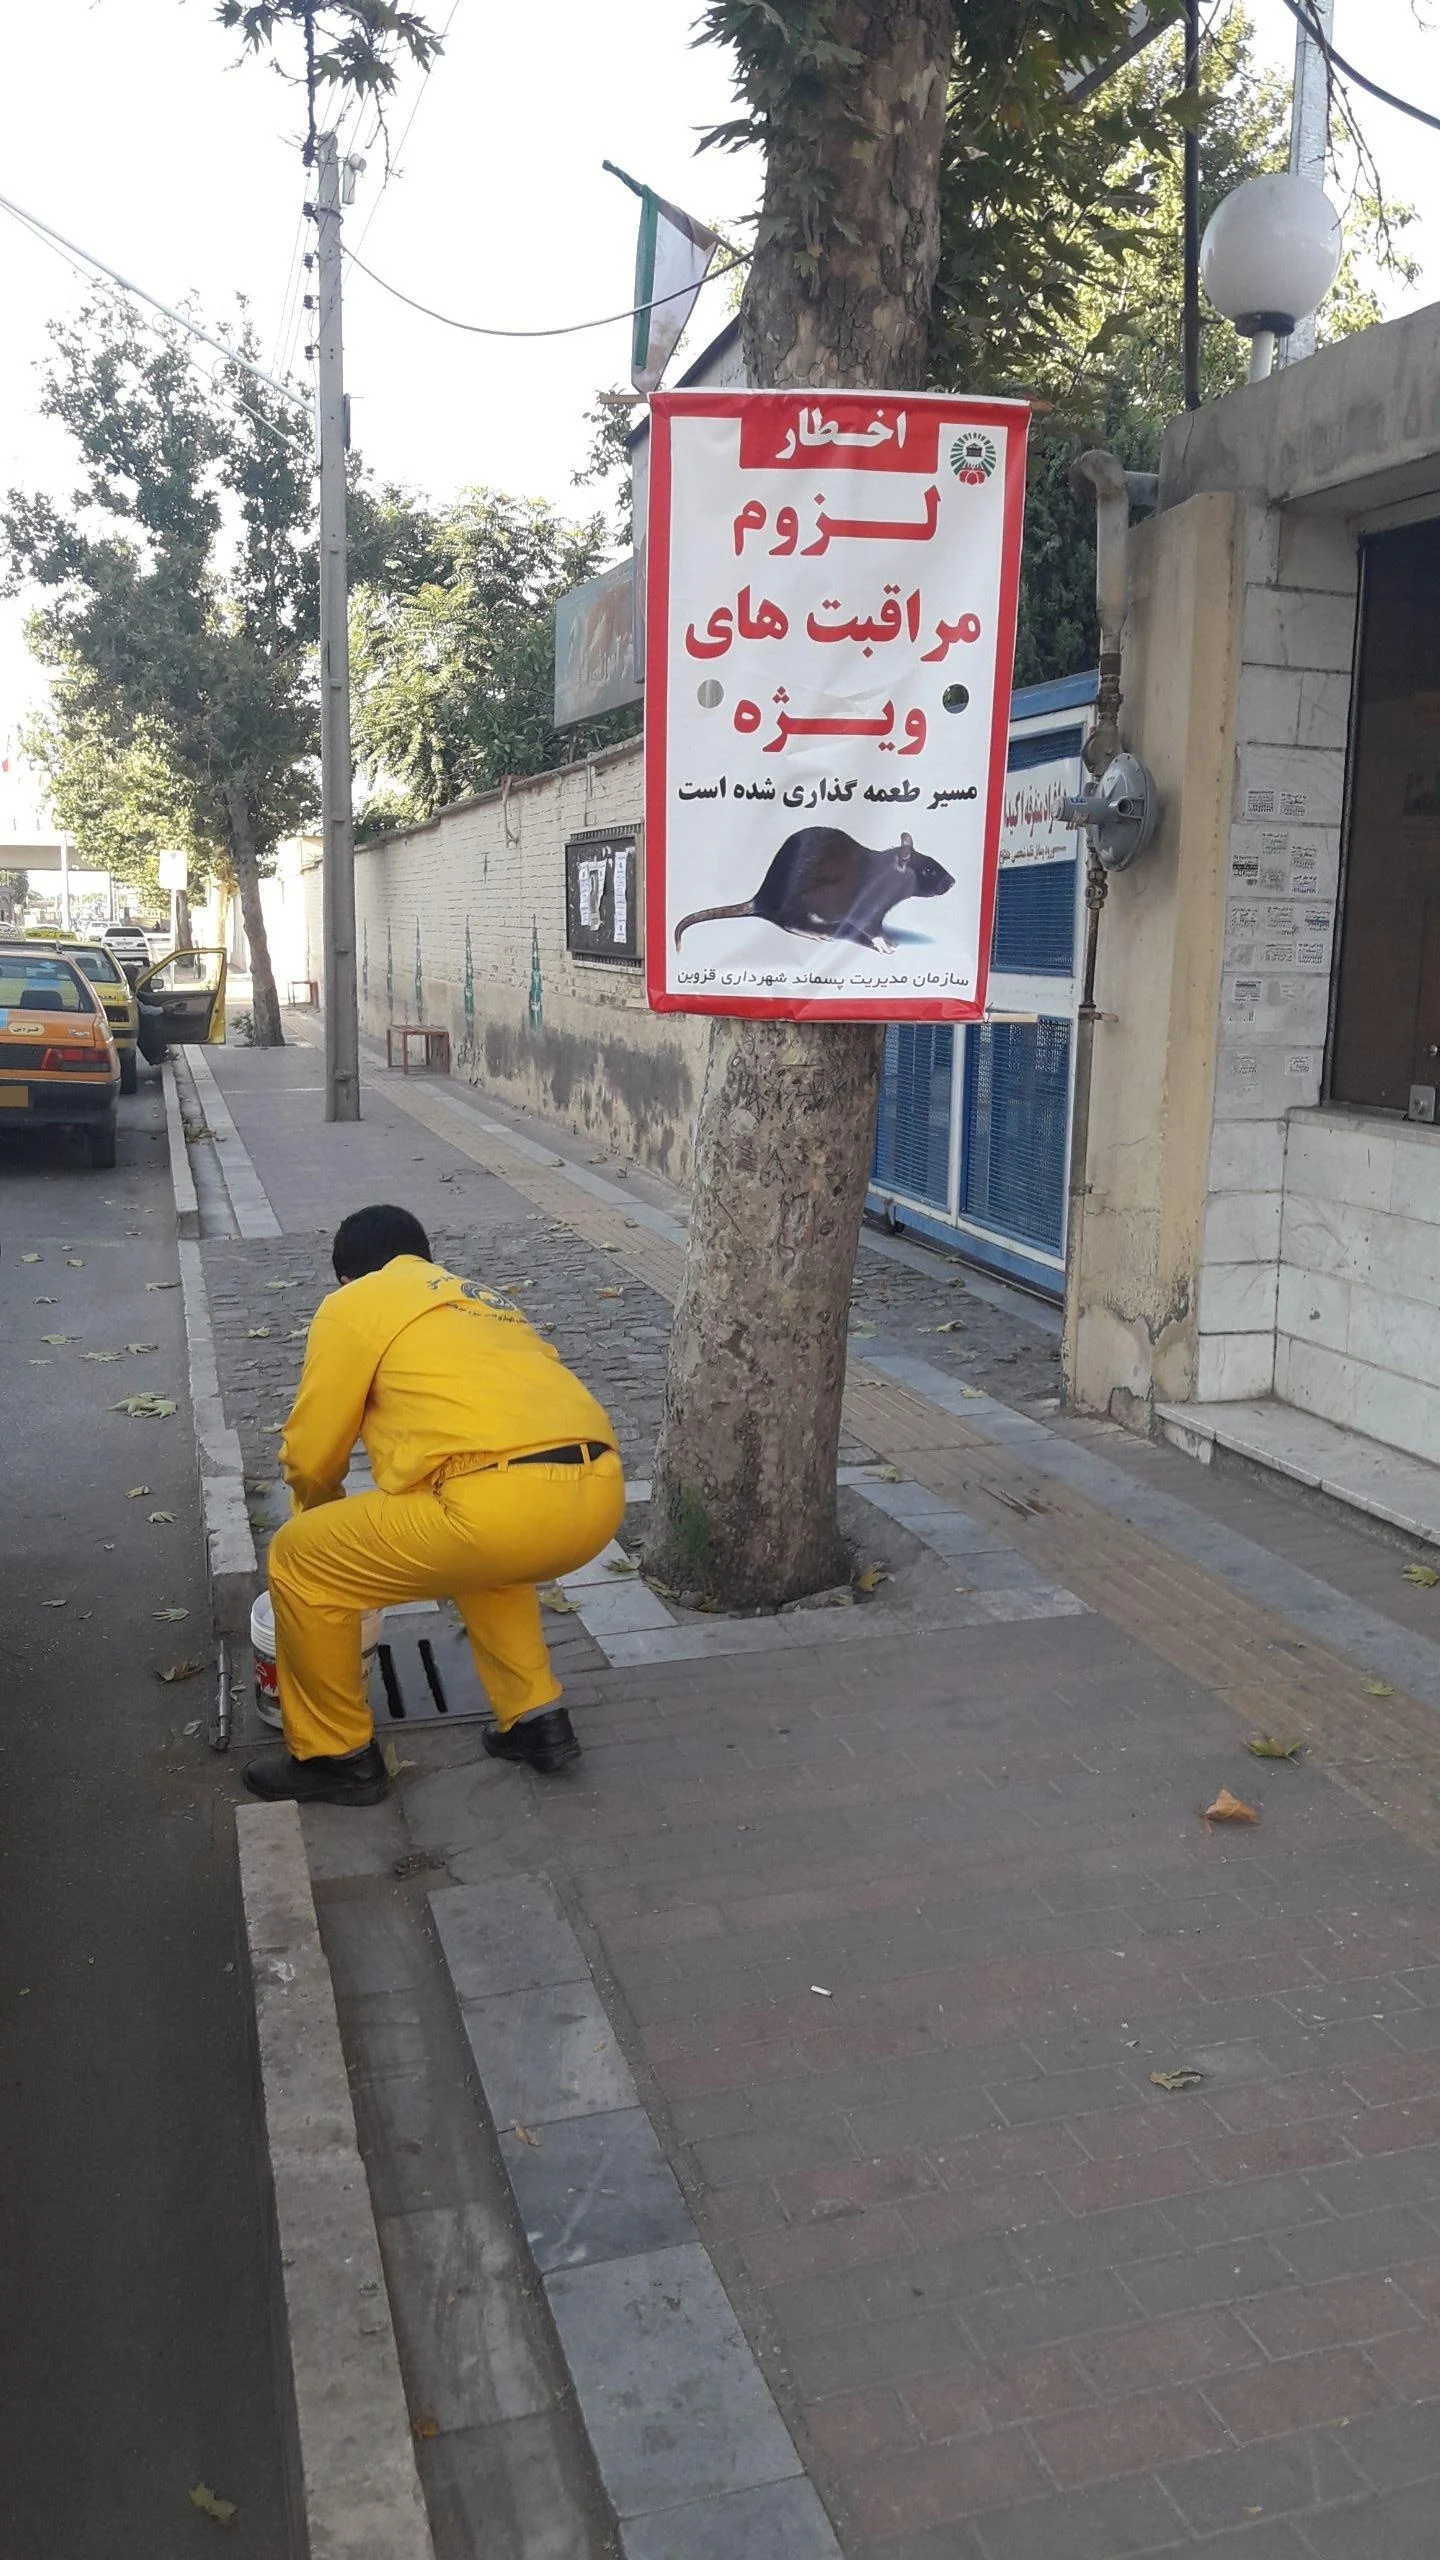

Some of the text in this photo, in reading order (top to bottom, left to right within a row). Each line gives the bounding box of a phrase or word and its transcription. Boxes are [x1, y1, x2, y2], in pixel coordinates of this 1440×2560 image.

[775, 408, 906, 459] اخطار
[733, 484, 941, 556] لزوم
[685, 585, 789, 659] های
[805, 583, 981, 662] مراقبت
[734, 686, 926, 755] ویژه
[678, 775, 978, 810] مسیر طعمه گذاری شده است
[677, 968, 969, 990] سازمان مدیریت پسماند شهرداری قزوین
